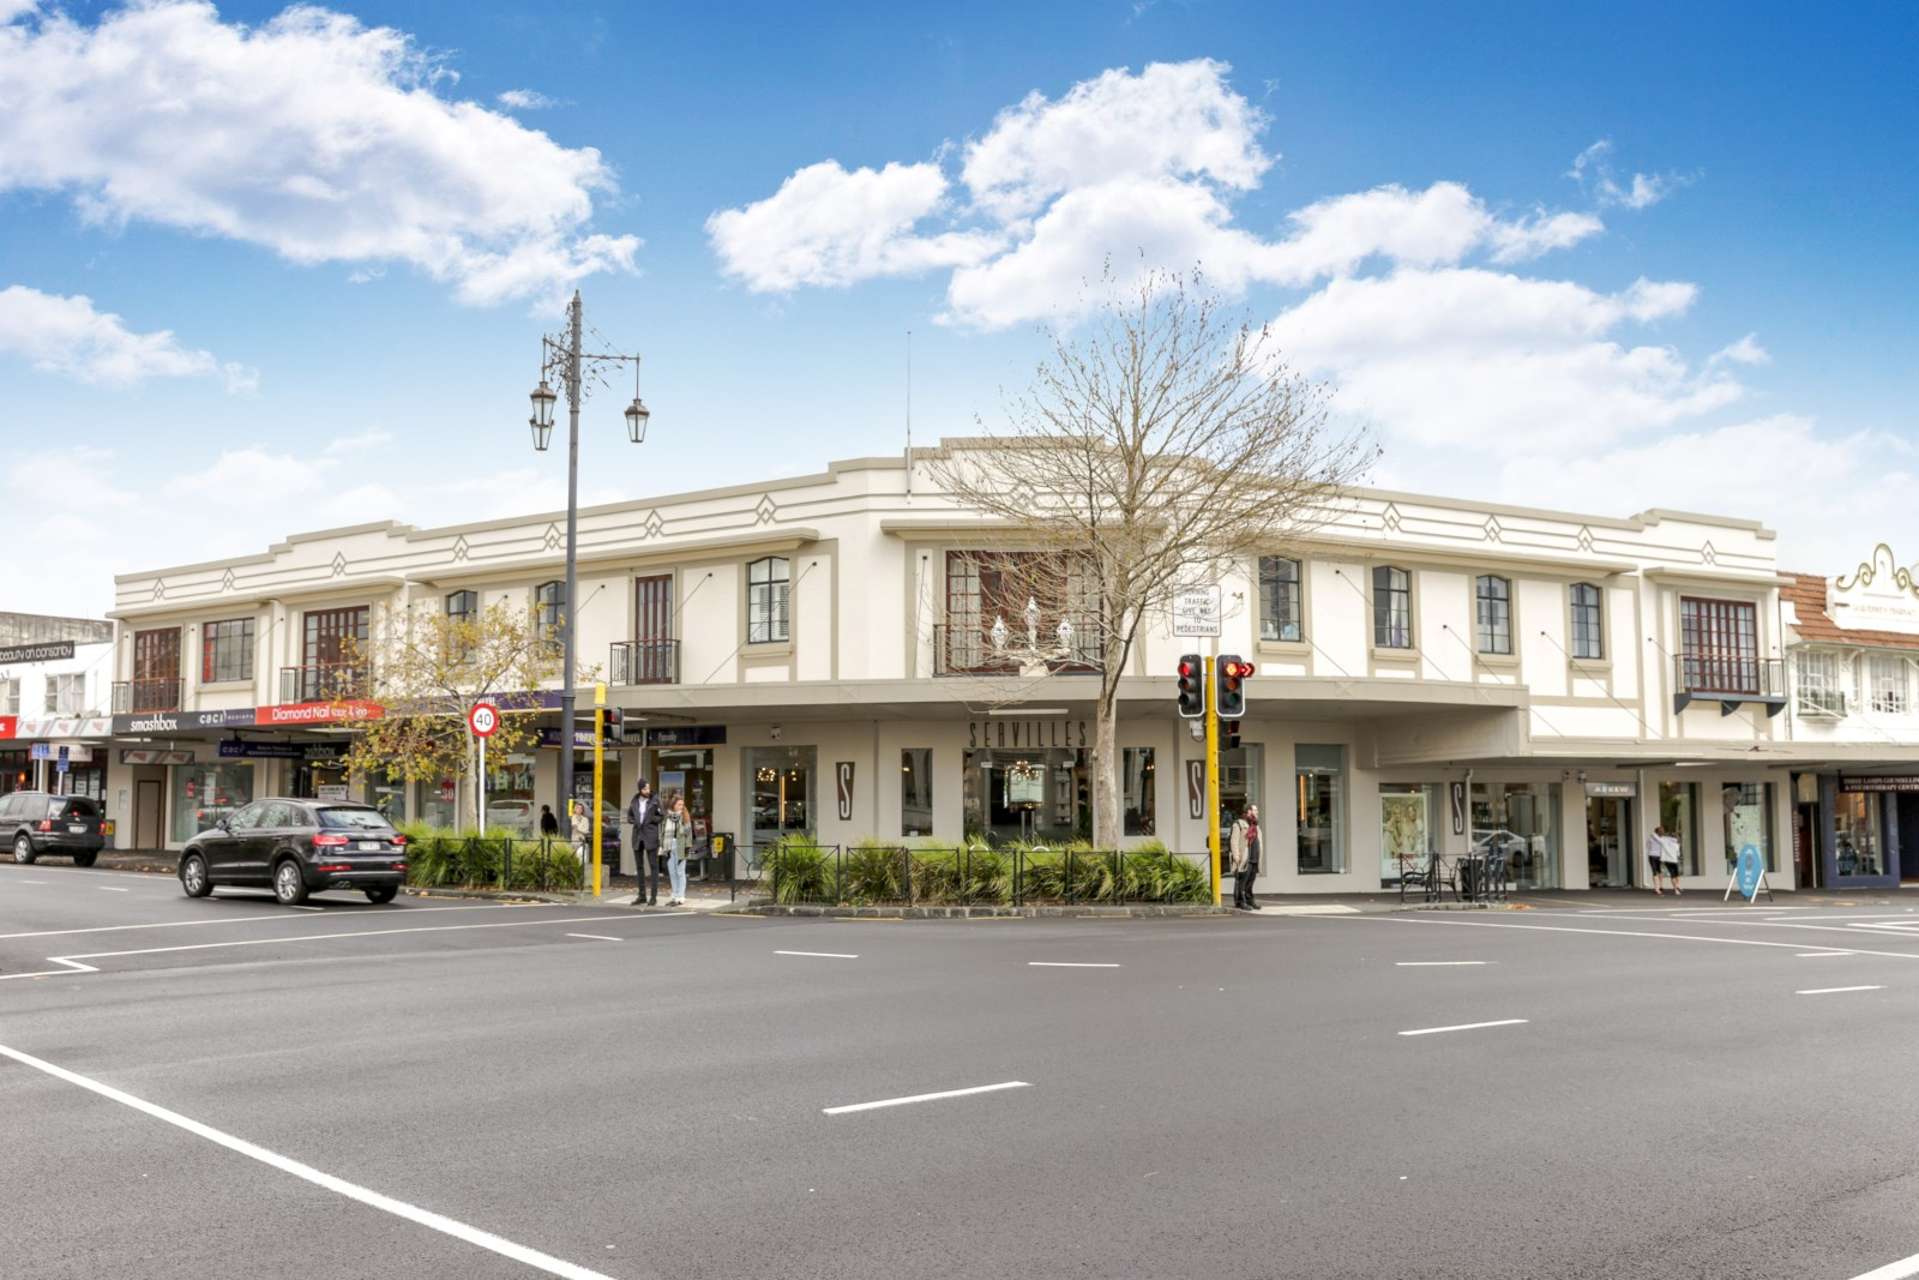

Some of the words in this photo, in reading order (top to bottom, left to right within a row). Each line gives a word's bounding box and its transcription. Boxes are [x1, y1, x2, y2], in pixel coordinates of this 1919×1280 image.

[1176, 625, 1217, 633] PEDESTRIANS
[130, 713, 177, 732] smashbox
[272, 707, 311, 720] Diamond
[312, 705, 329, 719] Nail
[476, 713, 491, 726] 40
[969, 721, 1086, 747] SERVILLES
[840, 763, 850, 818] S
[1191, 762, 1202, 817] S
[1454, 783, 1463, 833] S
